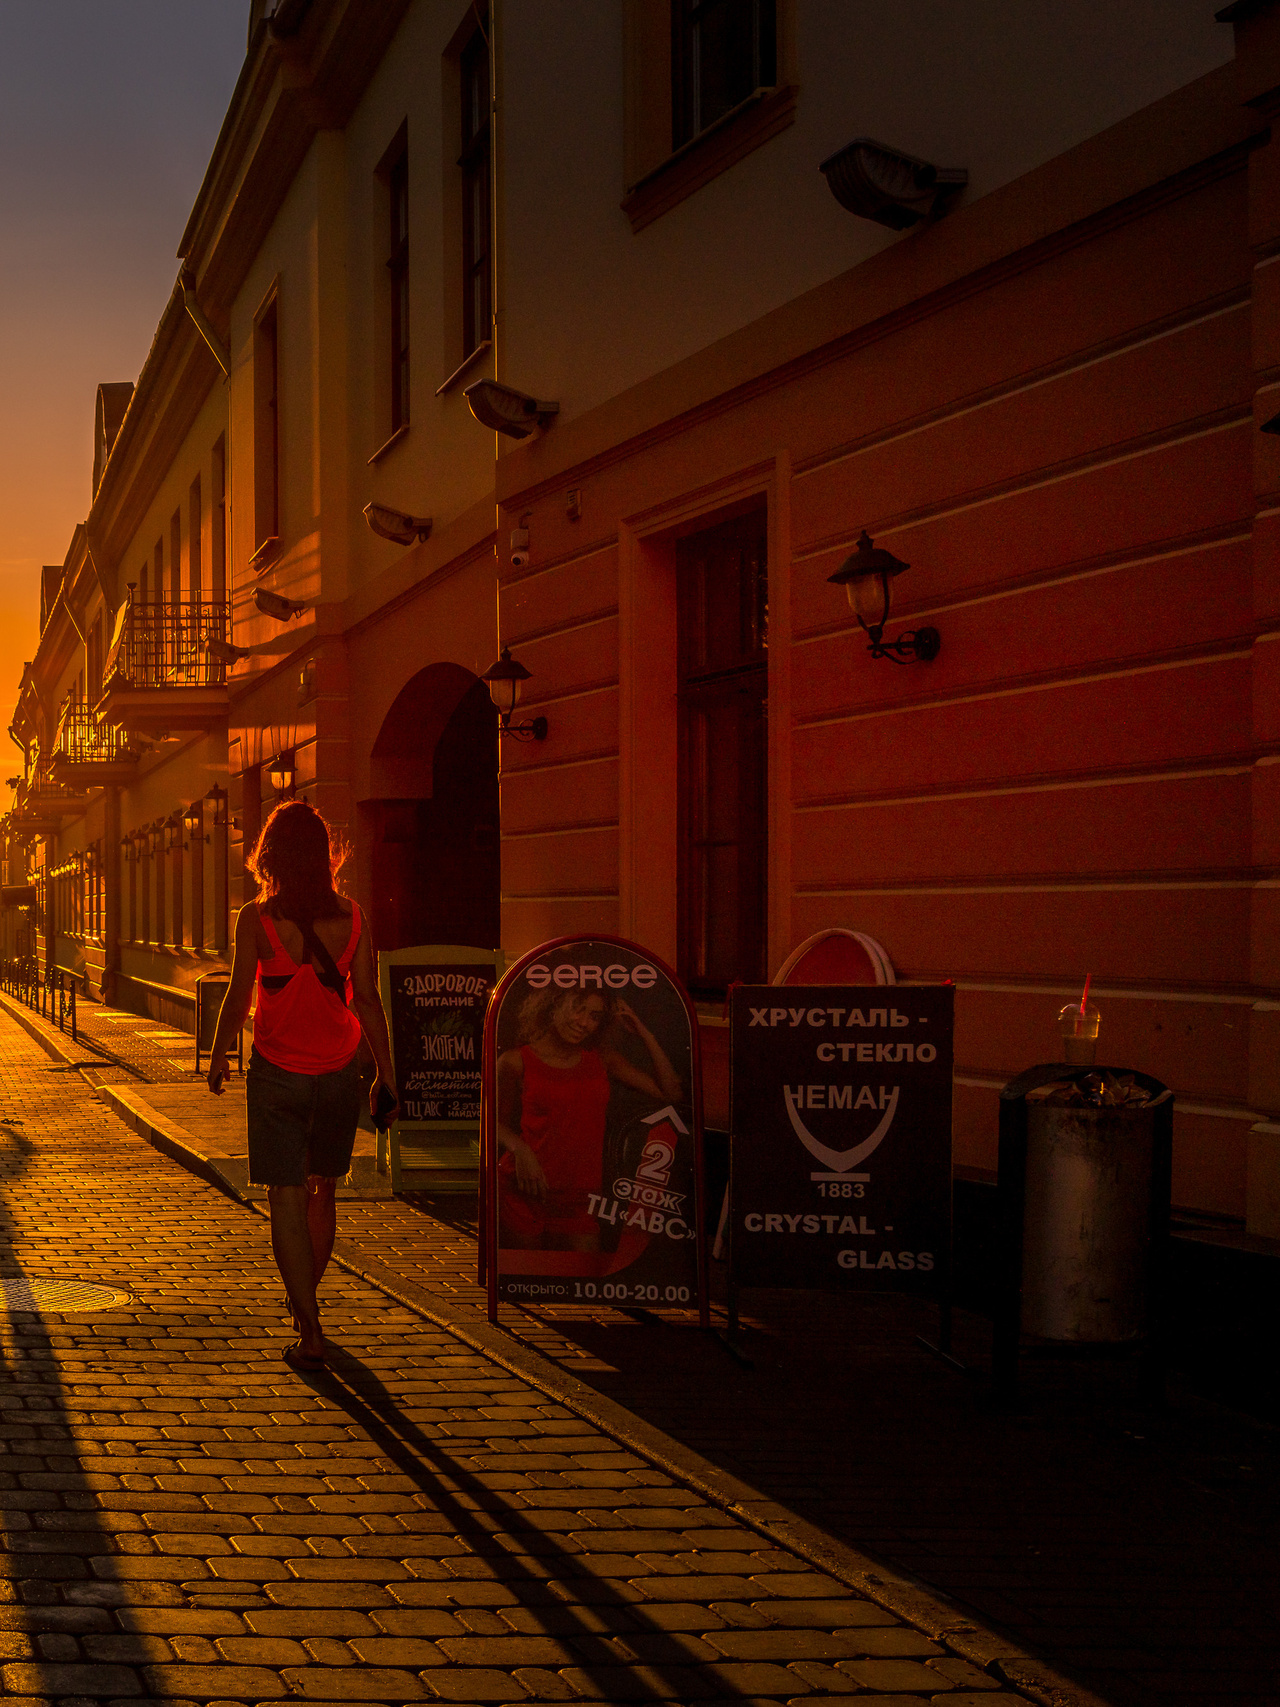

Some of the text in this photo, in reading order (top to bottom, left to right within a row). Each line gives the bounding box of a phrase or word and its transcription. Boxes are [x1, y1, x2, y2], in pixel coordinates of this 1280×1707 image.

[404, 974, 488, 997] ЗДОРОВОЕ
[415, 997, 475, 1008] ПИТАНИЕ
[748, 1007, 909, 1028] ХРУСТАЛЬ
[421, 1034, 475, 1062] ЭКОТЕМА
[816, 1043, 937, 1063] СТЕКЛО
[451, 1100, 460, 1111] 2
[783, 1085, 900, 1110] НЕМАН
[635, 1140, 675, 1185] 2
[817, 1182, 866, 1199] 1883
[744, 1213, 876, 1235] CRYSTAL
[836, 1249, 935, 1271] GLASS
[507, 1282, 690, 1302] открыто: 10.00-20.00
